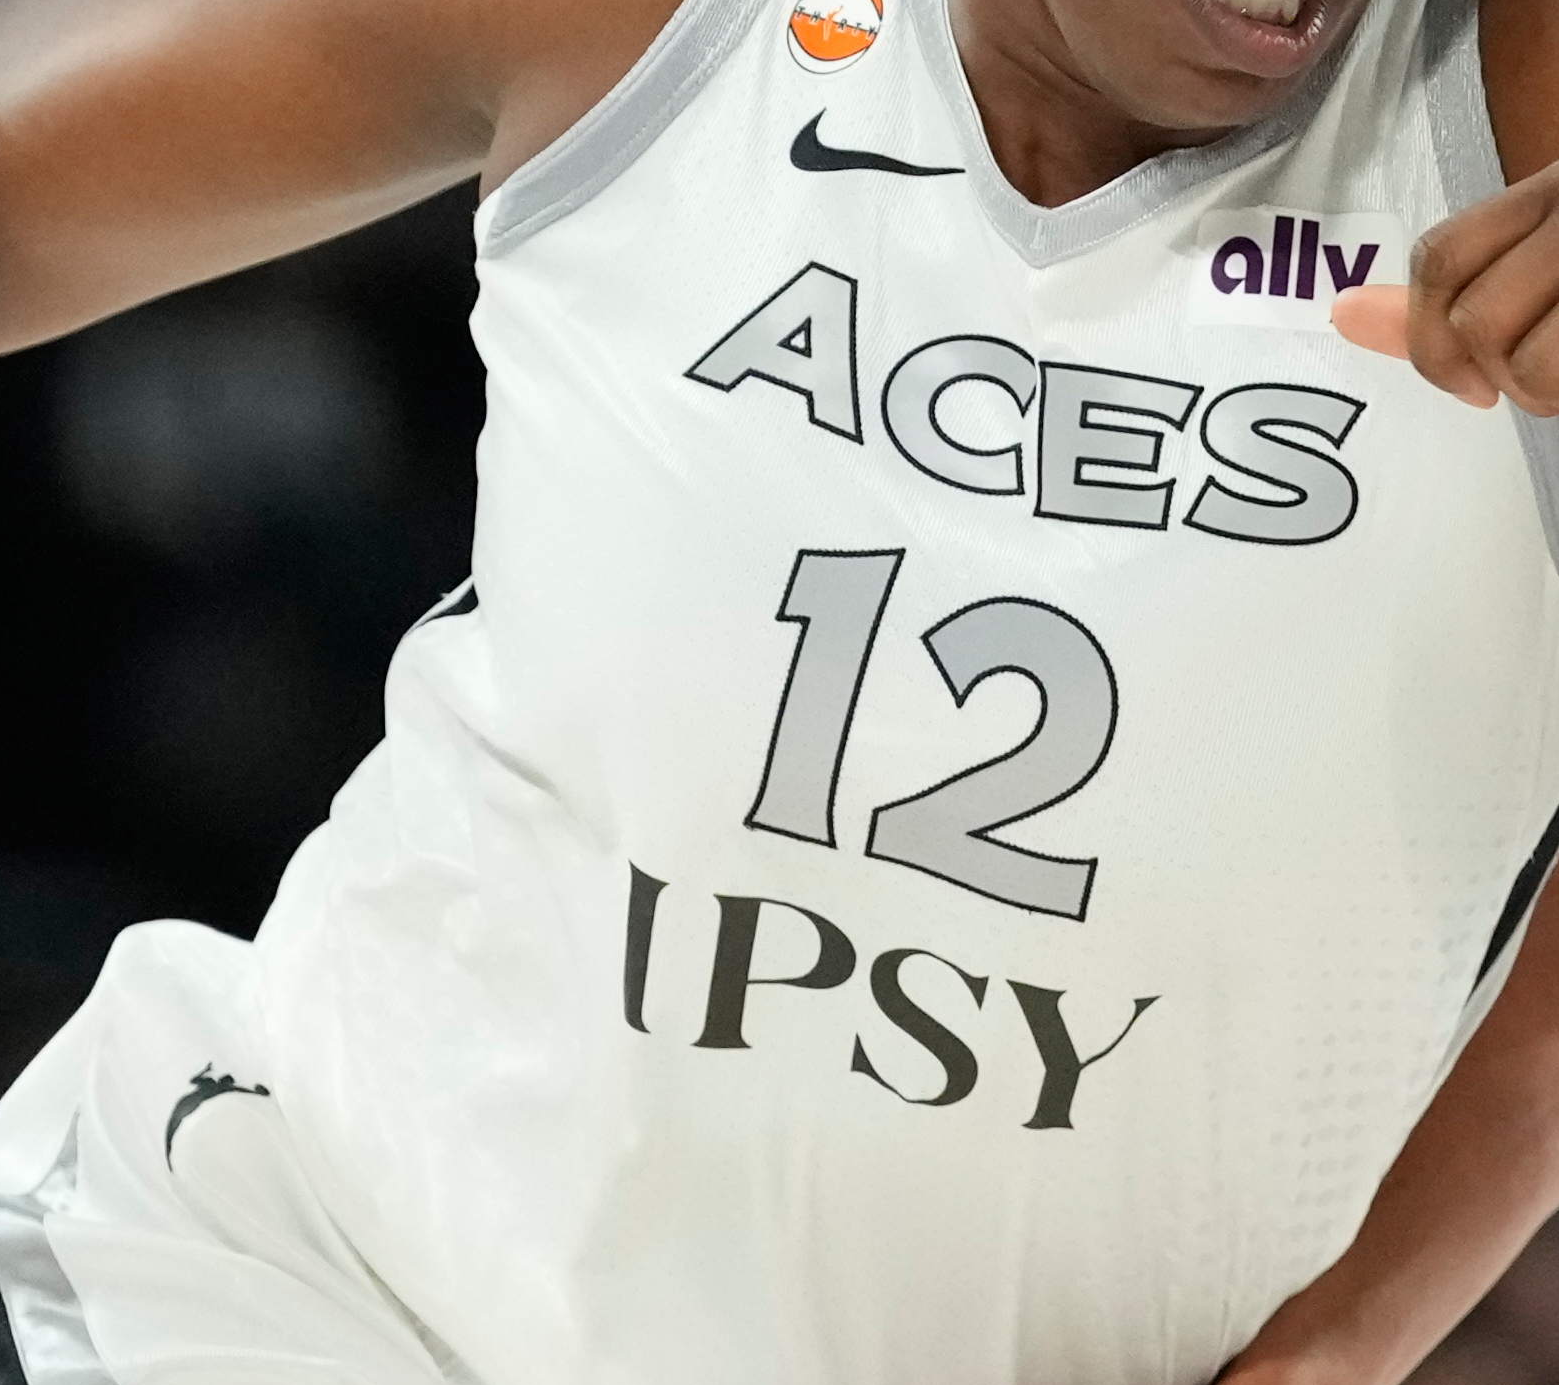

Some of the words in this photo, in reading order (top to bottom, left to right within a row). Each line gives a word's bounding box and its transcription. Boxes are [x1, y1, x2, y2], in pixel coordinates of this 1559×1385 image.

[683, 262, 1367, 545] ACES
[744, 549, 1119, 922] 12
[624, 860, 1162, 1129] IPSY
